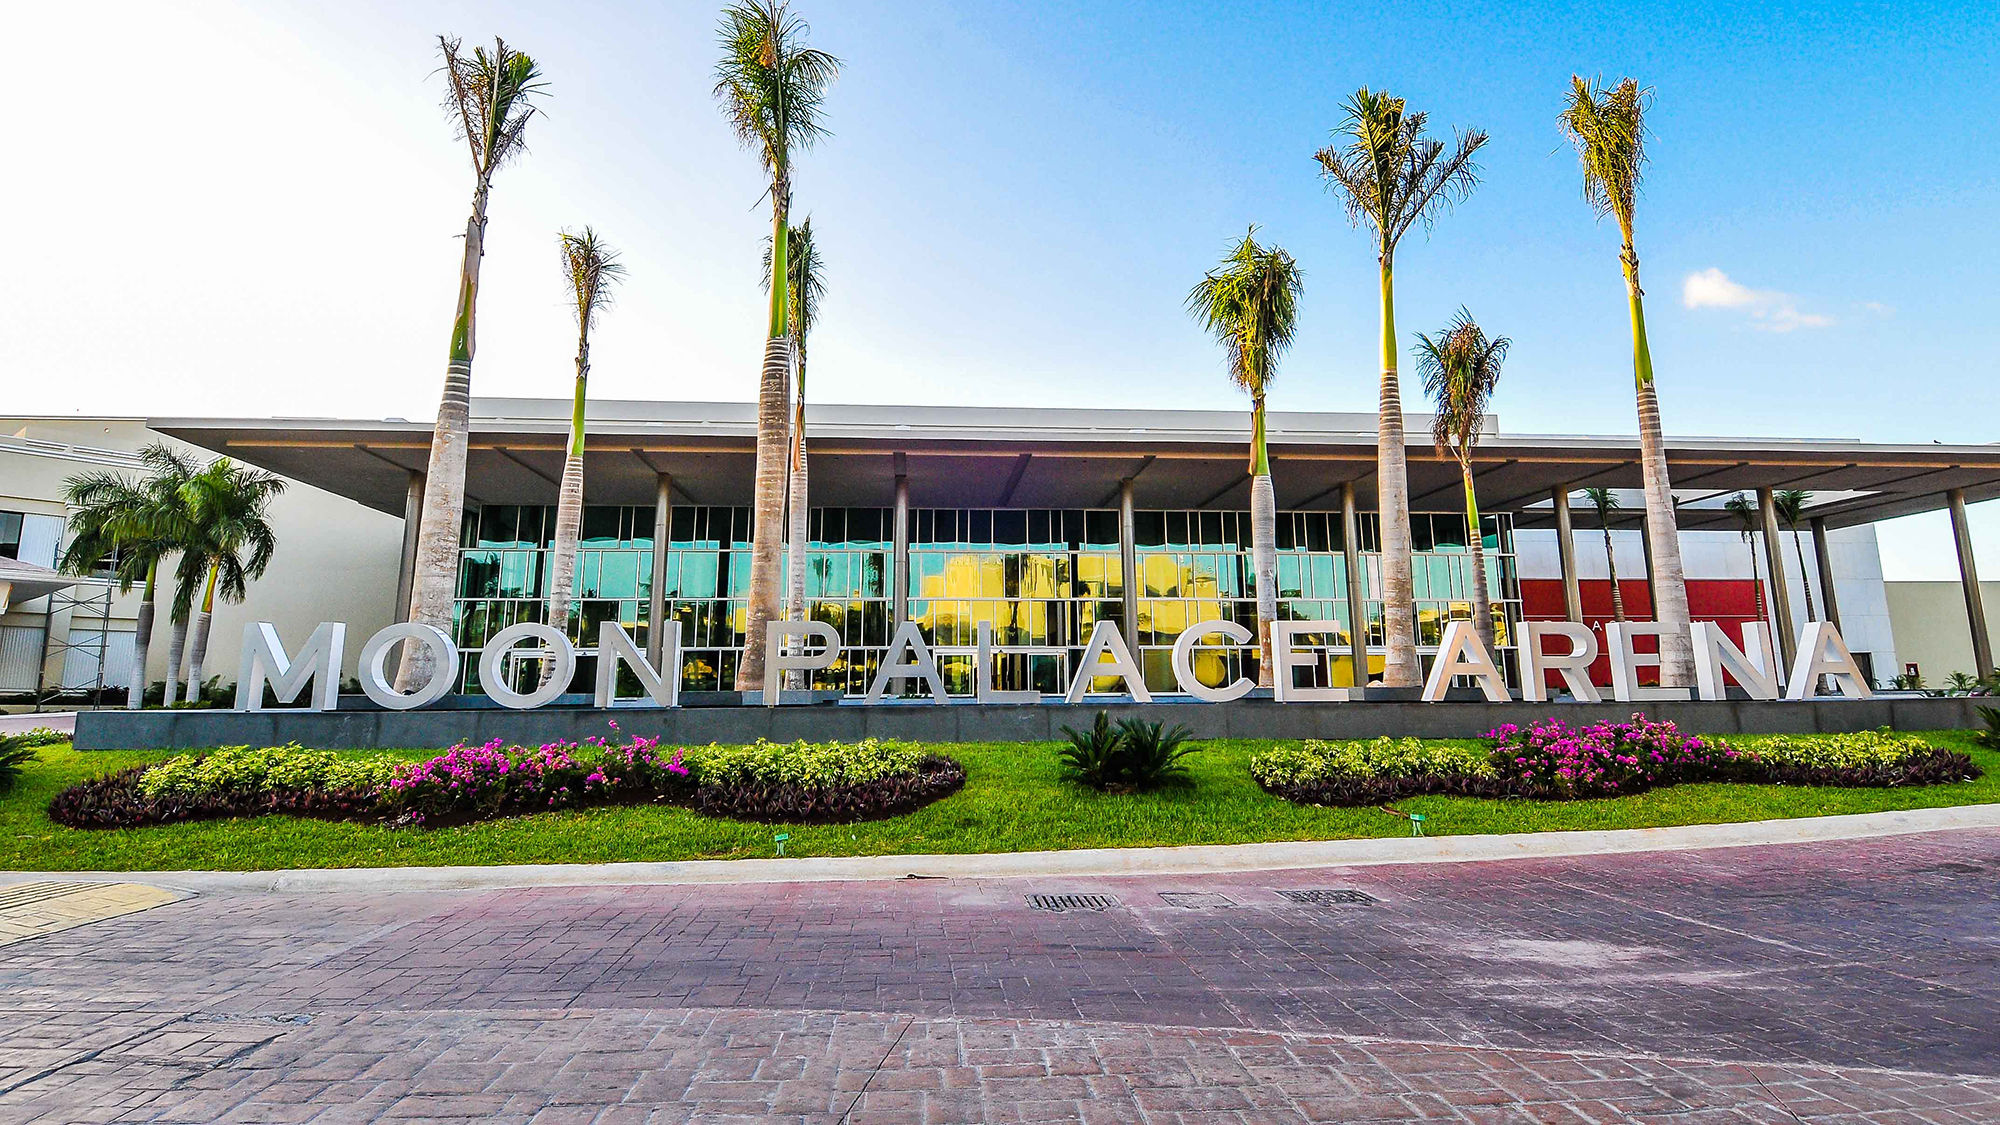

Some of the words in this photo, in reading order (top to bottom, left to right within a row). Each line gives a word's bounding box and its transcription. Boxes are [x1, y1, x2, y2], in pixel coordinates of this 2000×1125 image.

[234, 621, 682, 710] MOON
[763, 620, 1351, 703] PALACE
[1422, 621, 1872, 701] ARENA
